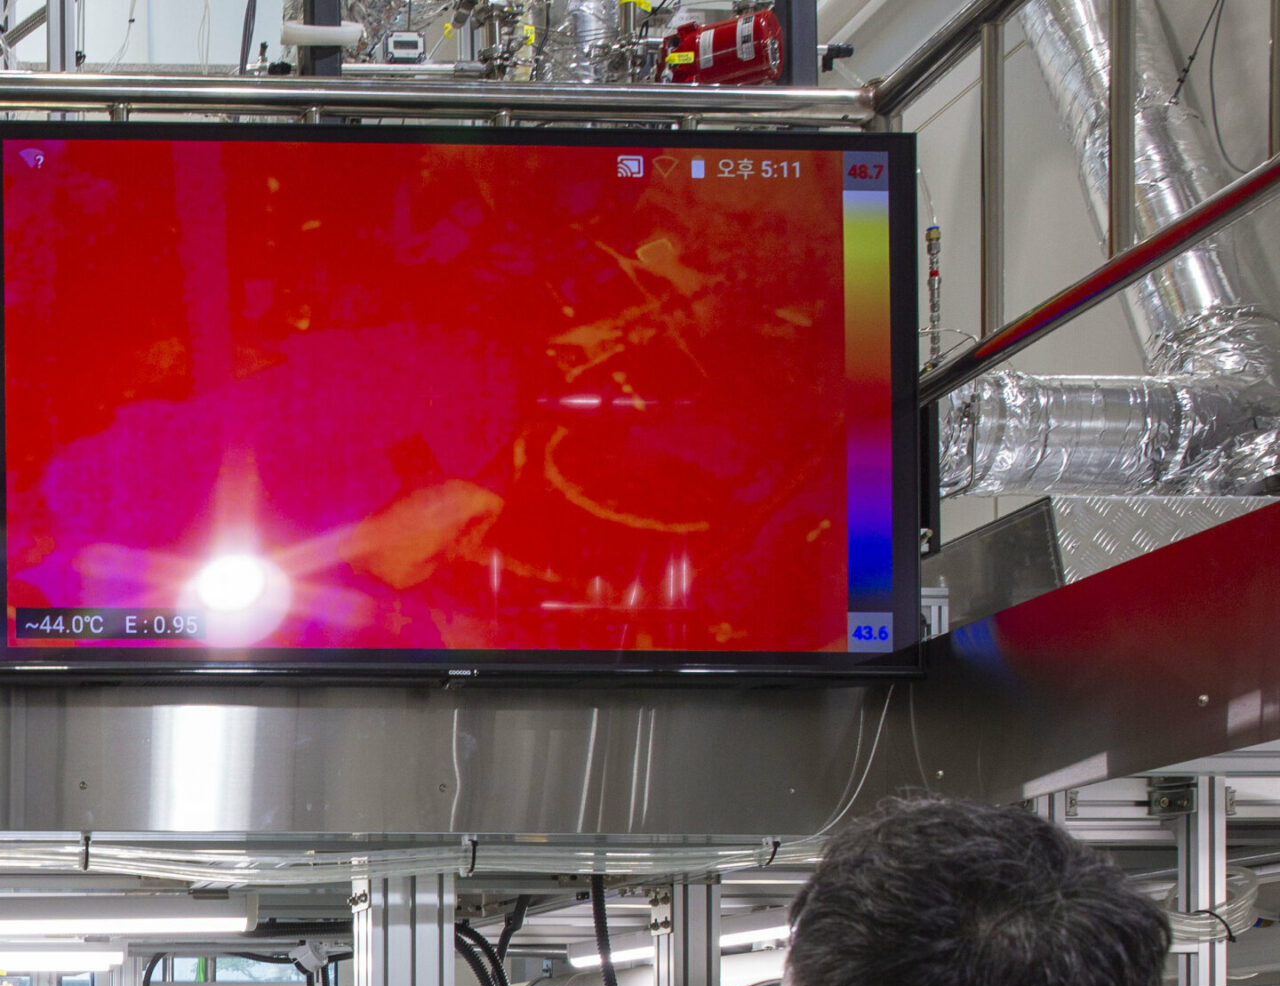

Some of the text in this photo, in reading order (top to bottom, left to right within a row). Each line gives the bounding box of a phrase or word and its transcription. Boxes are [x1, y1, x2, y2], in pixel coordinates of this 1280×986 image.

[717, 158, 801, 180] 오후 5:11
[847, 164, 884, 180] 48.7
[852, 625, 889, 641] 43.6
